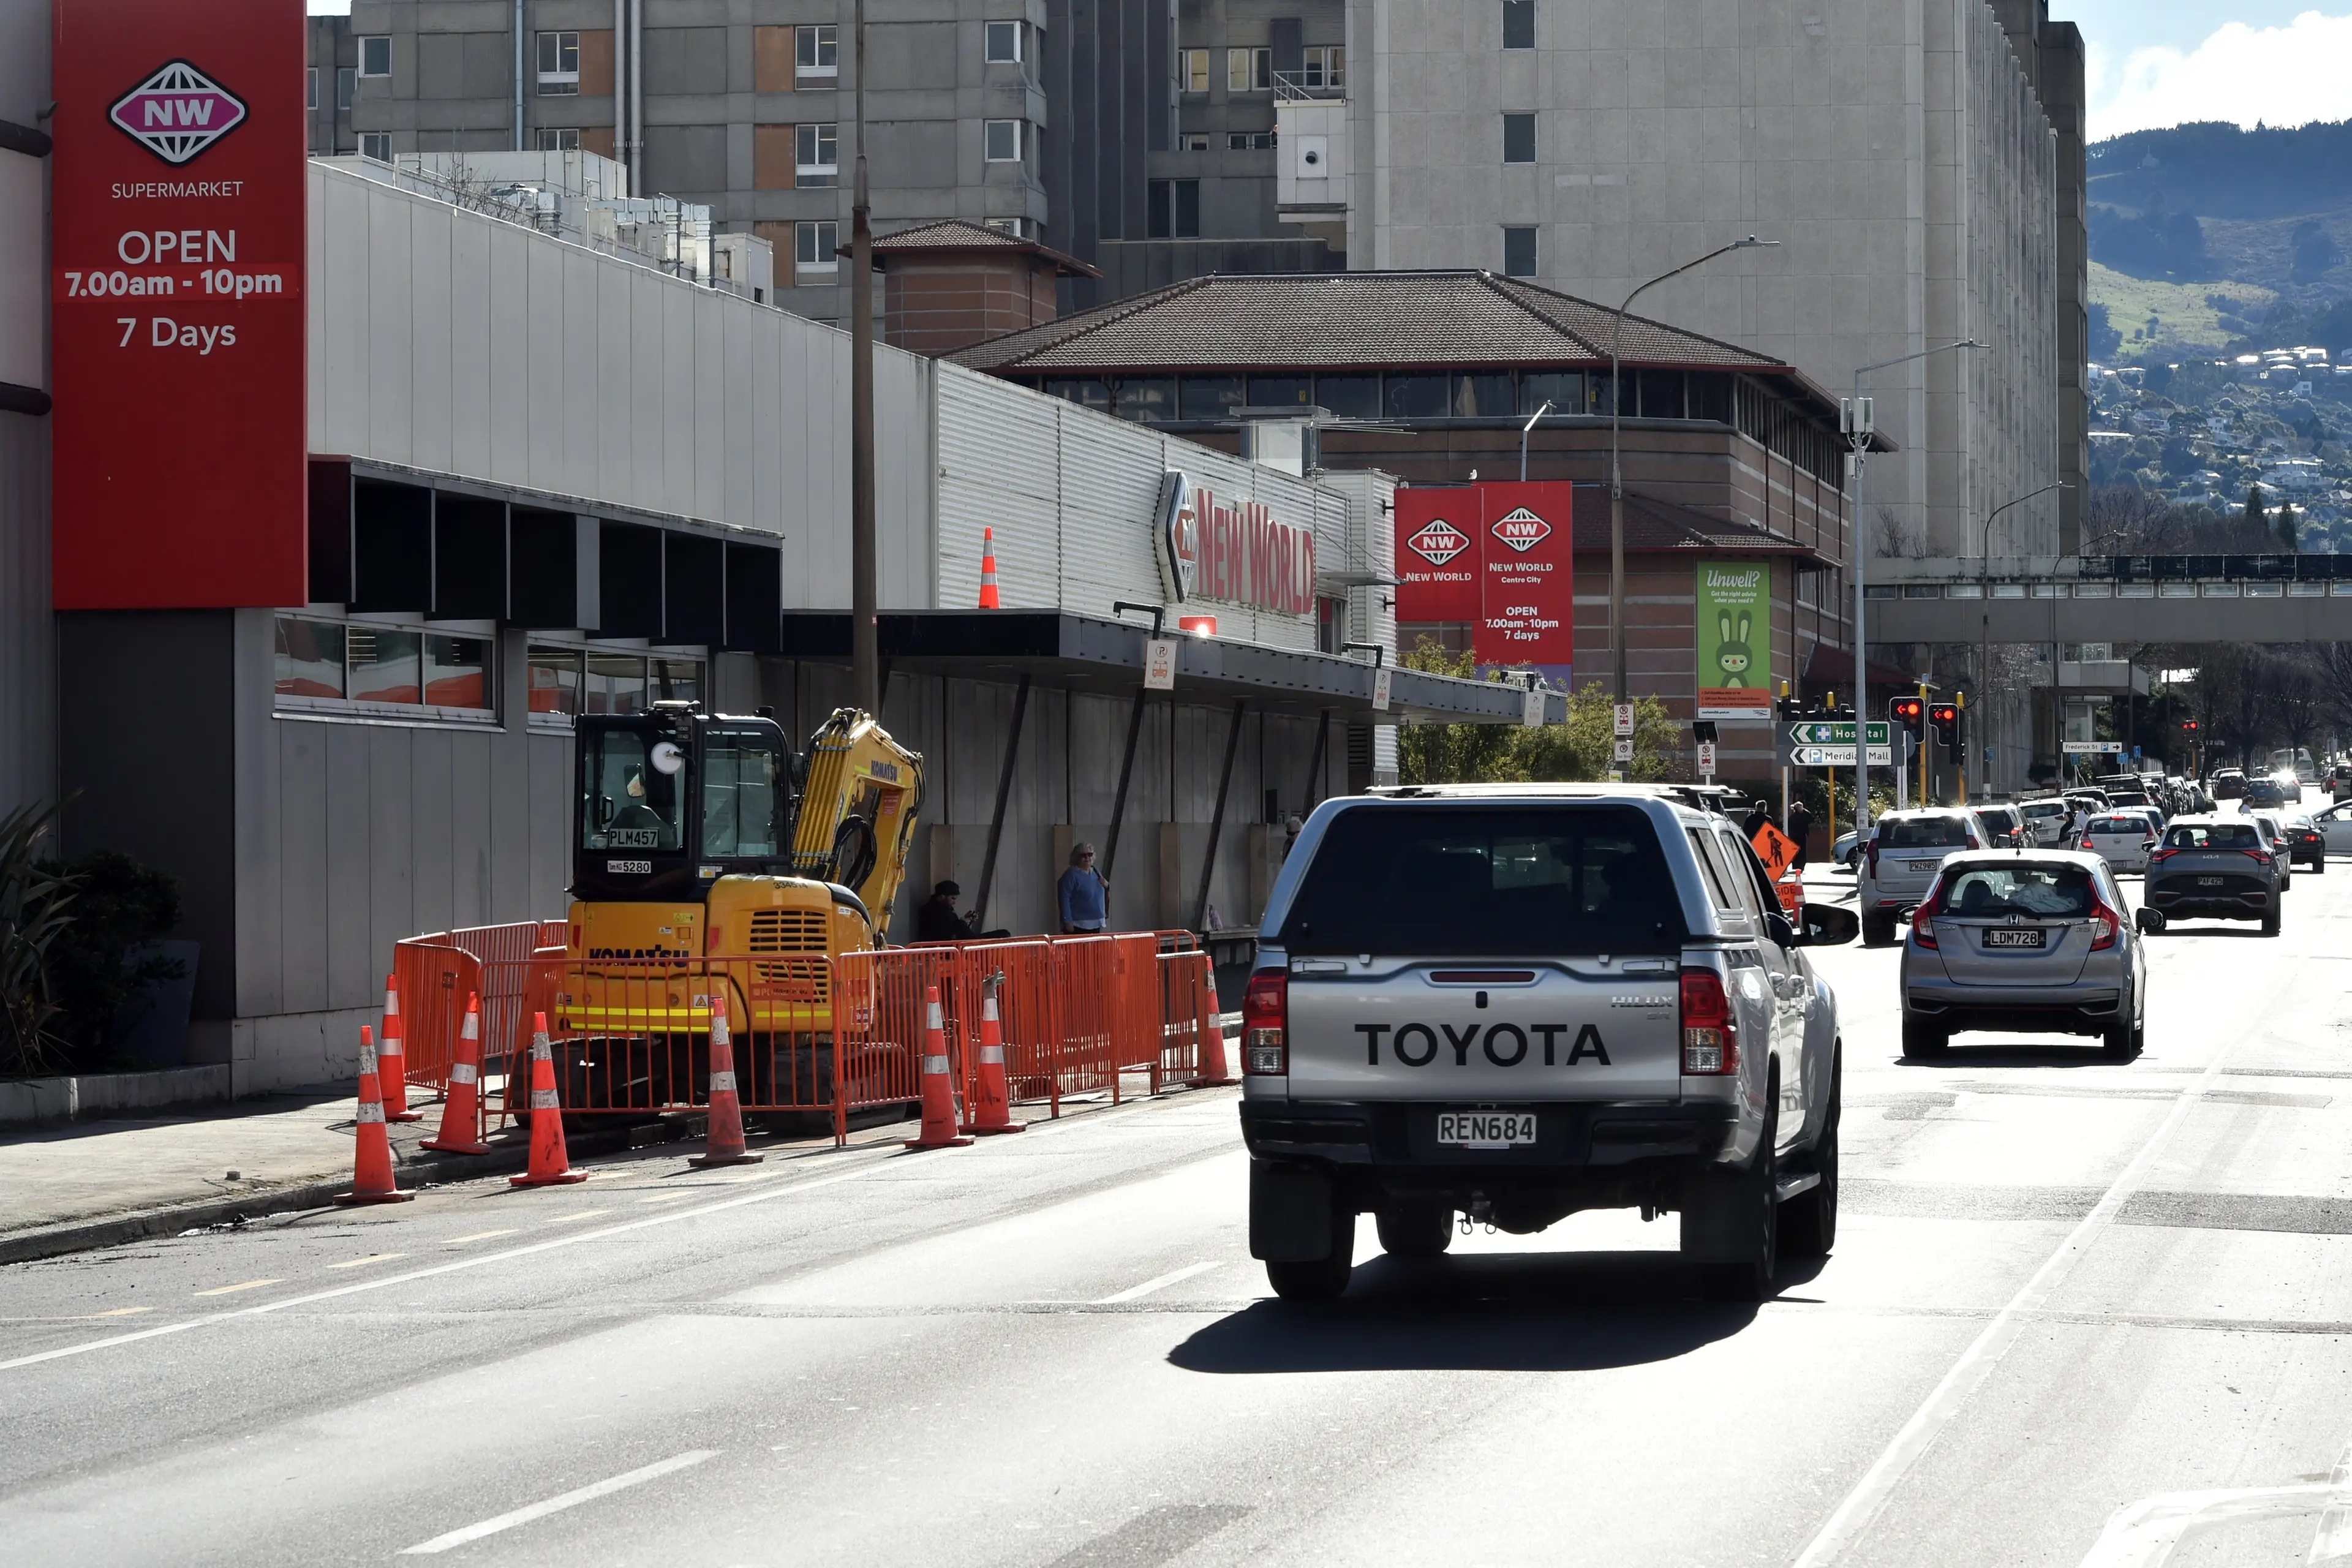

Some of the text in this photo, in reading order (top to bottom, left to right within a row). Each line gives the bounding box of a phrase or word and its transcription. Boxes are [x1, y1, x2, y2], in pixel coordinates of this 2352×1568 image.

[144, 99, 214, 126] NW
[111, 181, 244, 198] SUPERMARKET
[118, 230, 236, 265] OPEN
[64, 271, 174, 297] 7.00am
[200, 270, 283, 300] 10pm
[116, 317, 236, 355] 7 Days
[1506, 524, 1537, 535] NW
[1423, 536, 1455, 548] NW
[1197, 488, 1314, 614] NEW WORLD
[1489, 563, 1553, 571] NEW WORLD
[1406, 572, 1472, 581] NEW WORLD
[1707, 570, 1760, 588] Unwell?
[1506, 606, 1537, 616] OPEN
[1504, 630, 1539, 641] 7 days
[1836, 729, 1883, 738] Hostal
[871, 760, 897, 782] KOMATSU
[610, 831, 657, 845] PLM457
[624, 862, 649, 872] 5280
[1992, 932, 2037, 944] LDM728
[1611, 996, 1673, 1008] HILUX
[1355, 1023, 1611, 1067] TOYOTA
[1441, 1117, 1533, 1140] REN684
